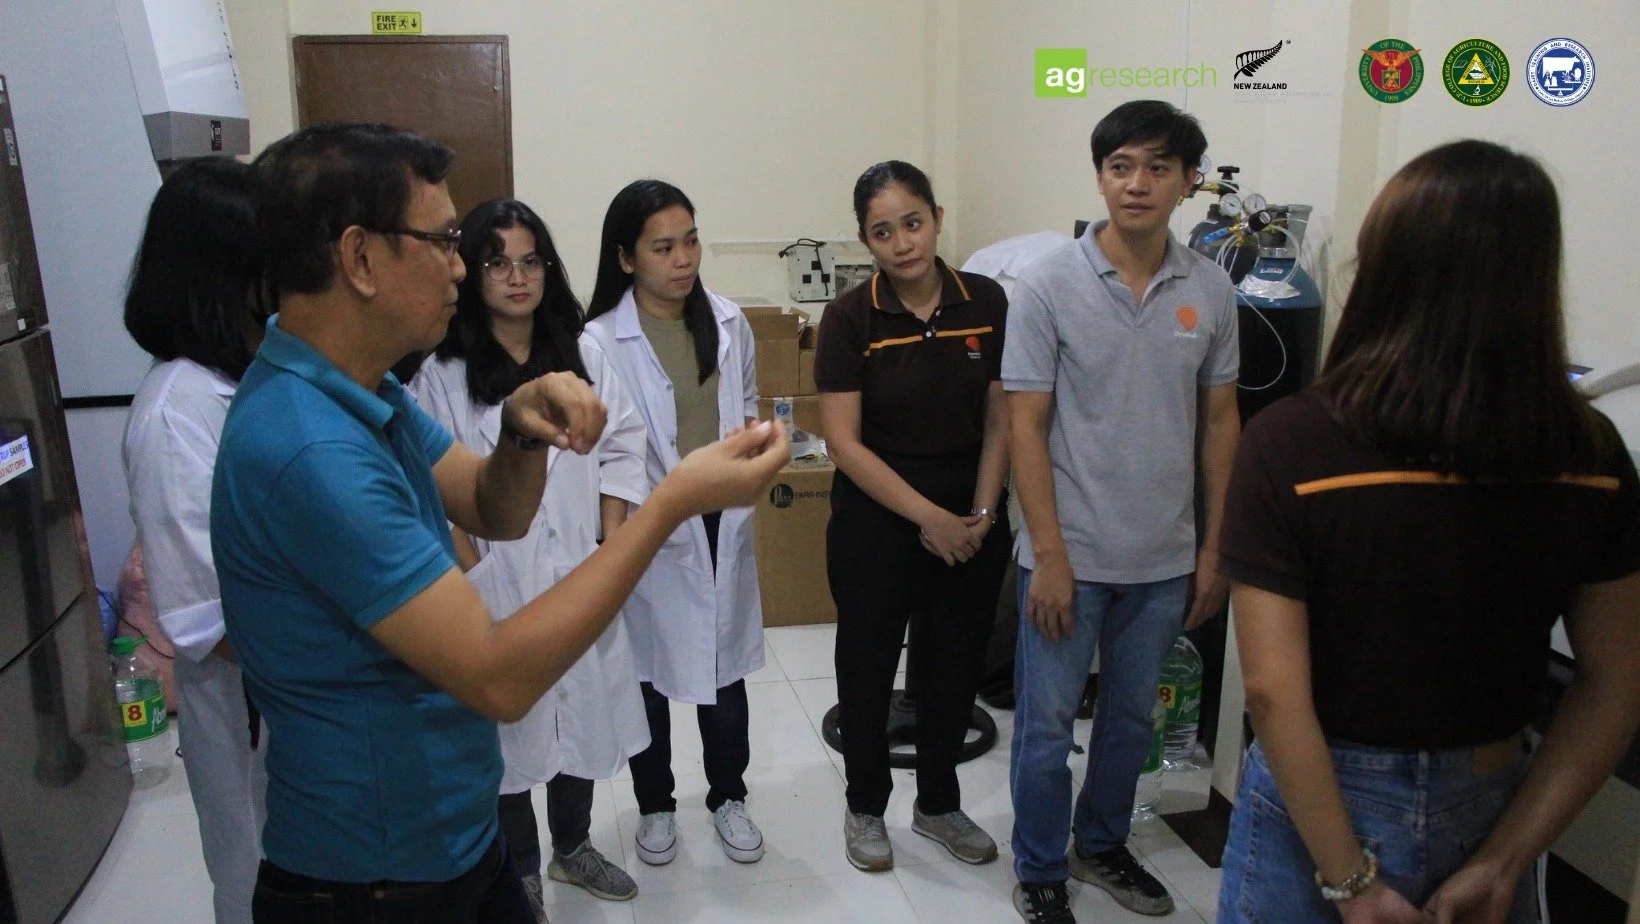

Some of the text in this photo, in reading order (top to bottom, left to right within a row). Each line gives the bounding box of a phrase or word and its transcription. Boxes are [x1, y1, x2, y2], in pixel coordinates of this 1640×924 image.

[376, 15, 396, 23] FIRE
[1158, 686, 1172, 704] 8
[127, 704, 142, 722] 8
